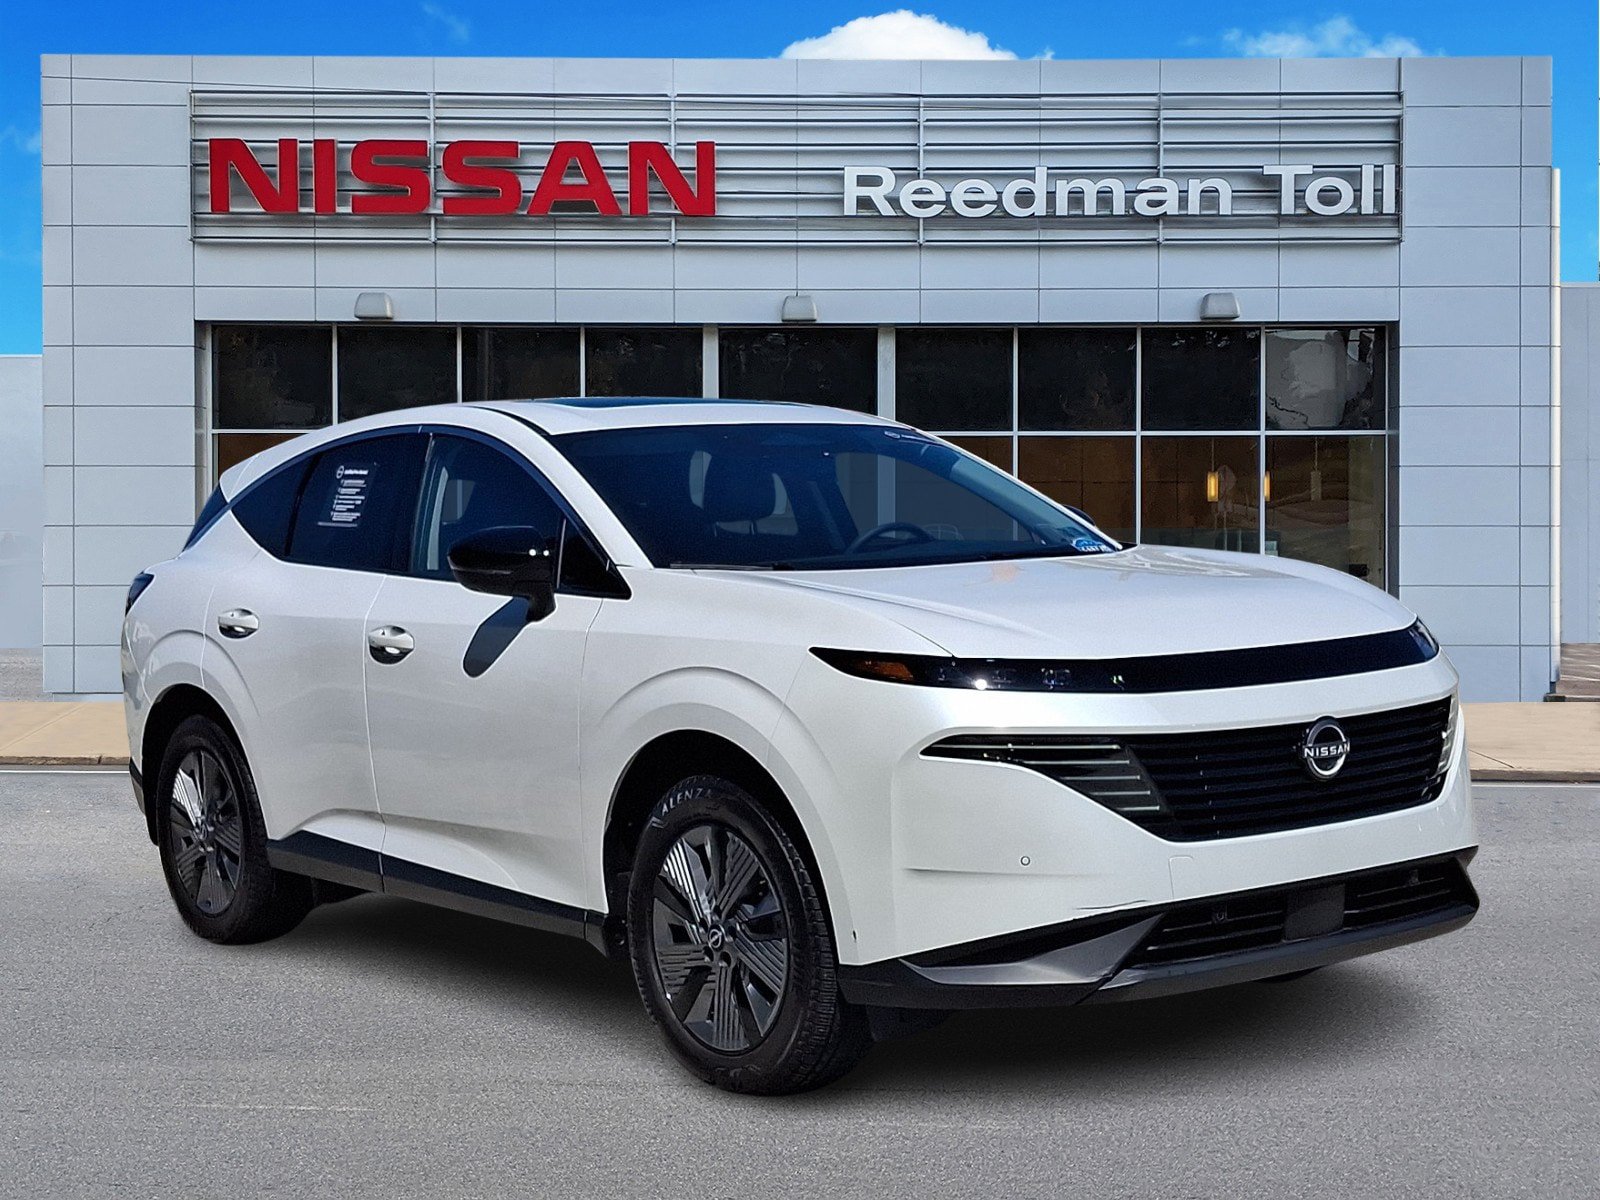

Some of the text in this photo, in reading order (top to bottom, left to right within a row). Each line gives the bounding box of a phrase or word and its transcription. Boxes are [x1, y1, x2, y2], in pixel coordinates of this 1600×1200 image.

[208, 138, 717, 217] NISSAN
[842, 163, 1397, 218] Reedman Toll
[1304, 742, 1350, 758] NISSAN
